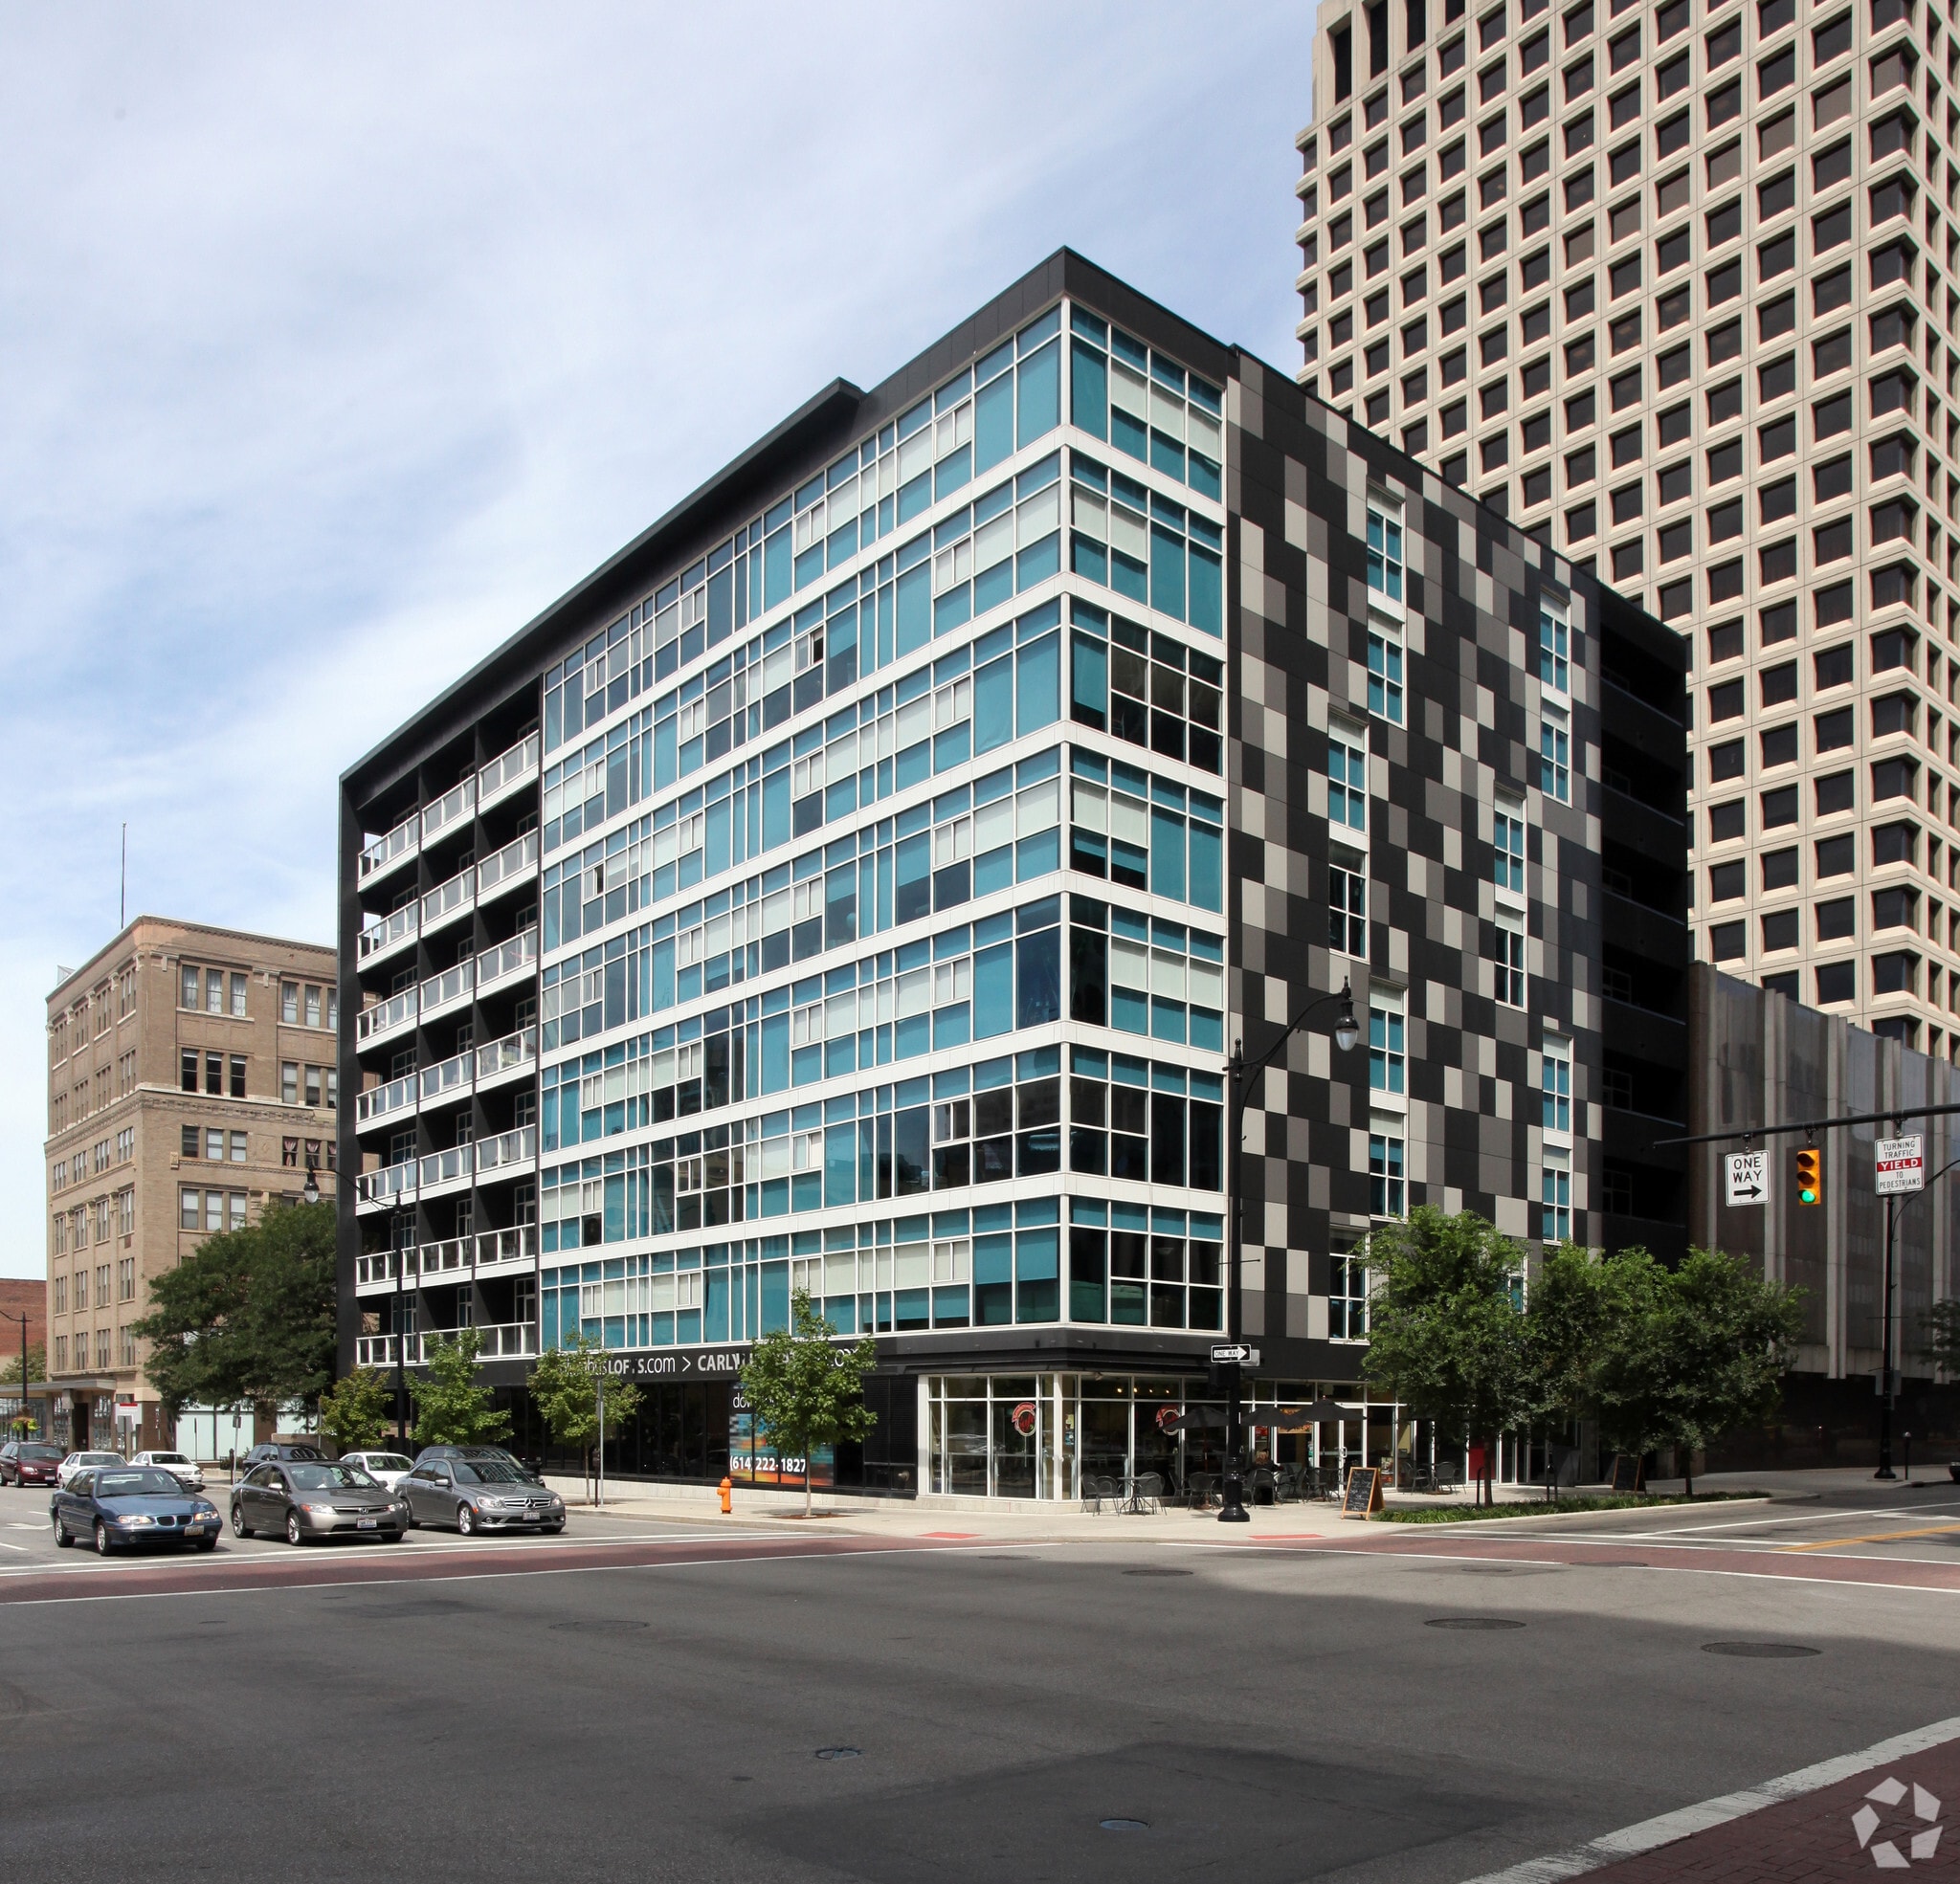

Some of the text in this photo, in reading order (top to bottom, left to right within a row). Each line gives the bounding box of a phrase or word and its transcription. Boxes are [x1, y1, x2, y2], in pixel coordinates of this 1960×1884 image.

[1882, 1141, 1915, 1151] TURNING
[1884, 1149, 1914, 1159] TRAFFIC
[1733, 1156, 1761, 1169] ONE
[1881, 1159, 1919, 1171] YIELD
[1732, 1169, 1762, 1183] WAY
[1879, 1178, 1921, 1189] PEDESTRIANS
